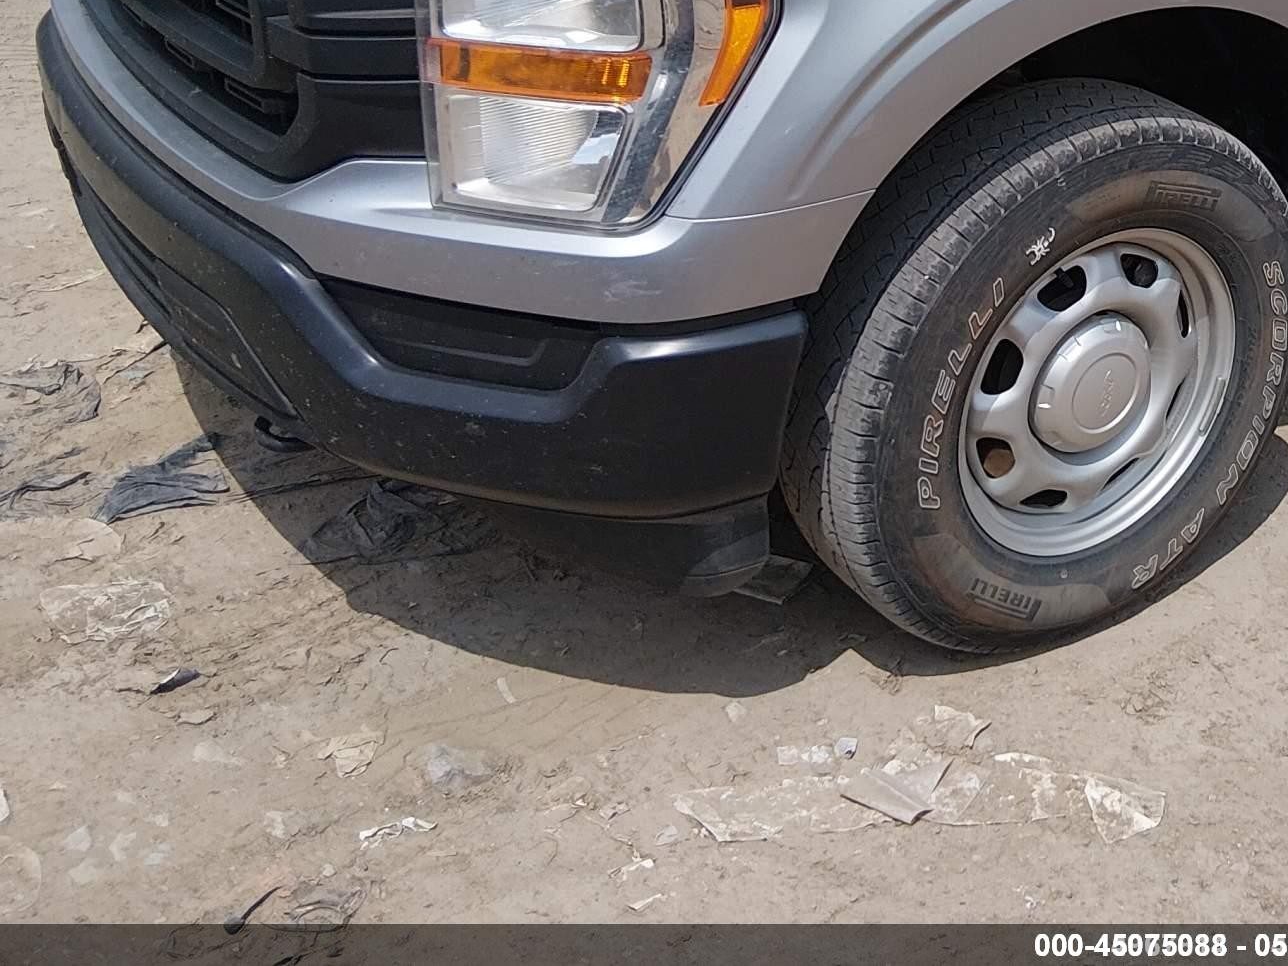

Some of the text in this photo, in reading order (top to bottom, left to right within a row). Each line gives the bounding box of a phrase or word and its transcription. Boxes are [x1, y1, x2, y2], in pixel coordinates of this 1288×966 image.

[1143, 180, 1222, 211] PIRELLI
[917, 277, 1005, 509] PIRELLI
[1131, 260, 1288, 590] SCORPION ATR
[966, 578, 1042, 622] PIRELLI
